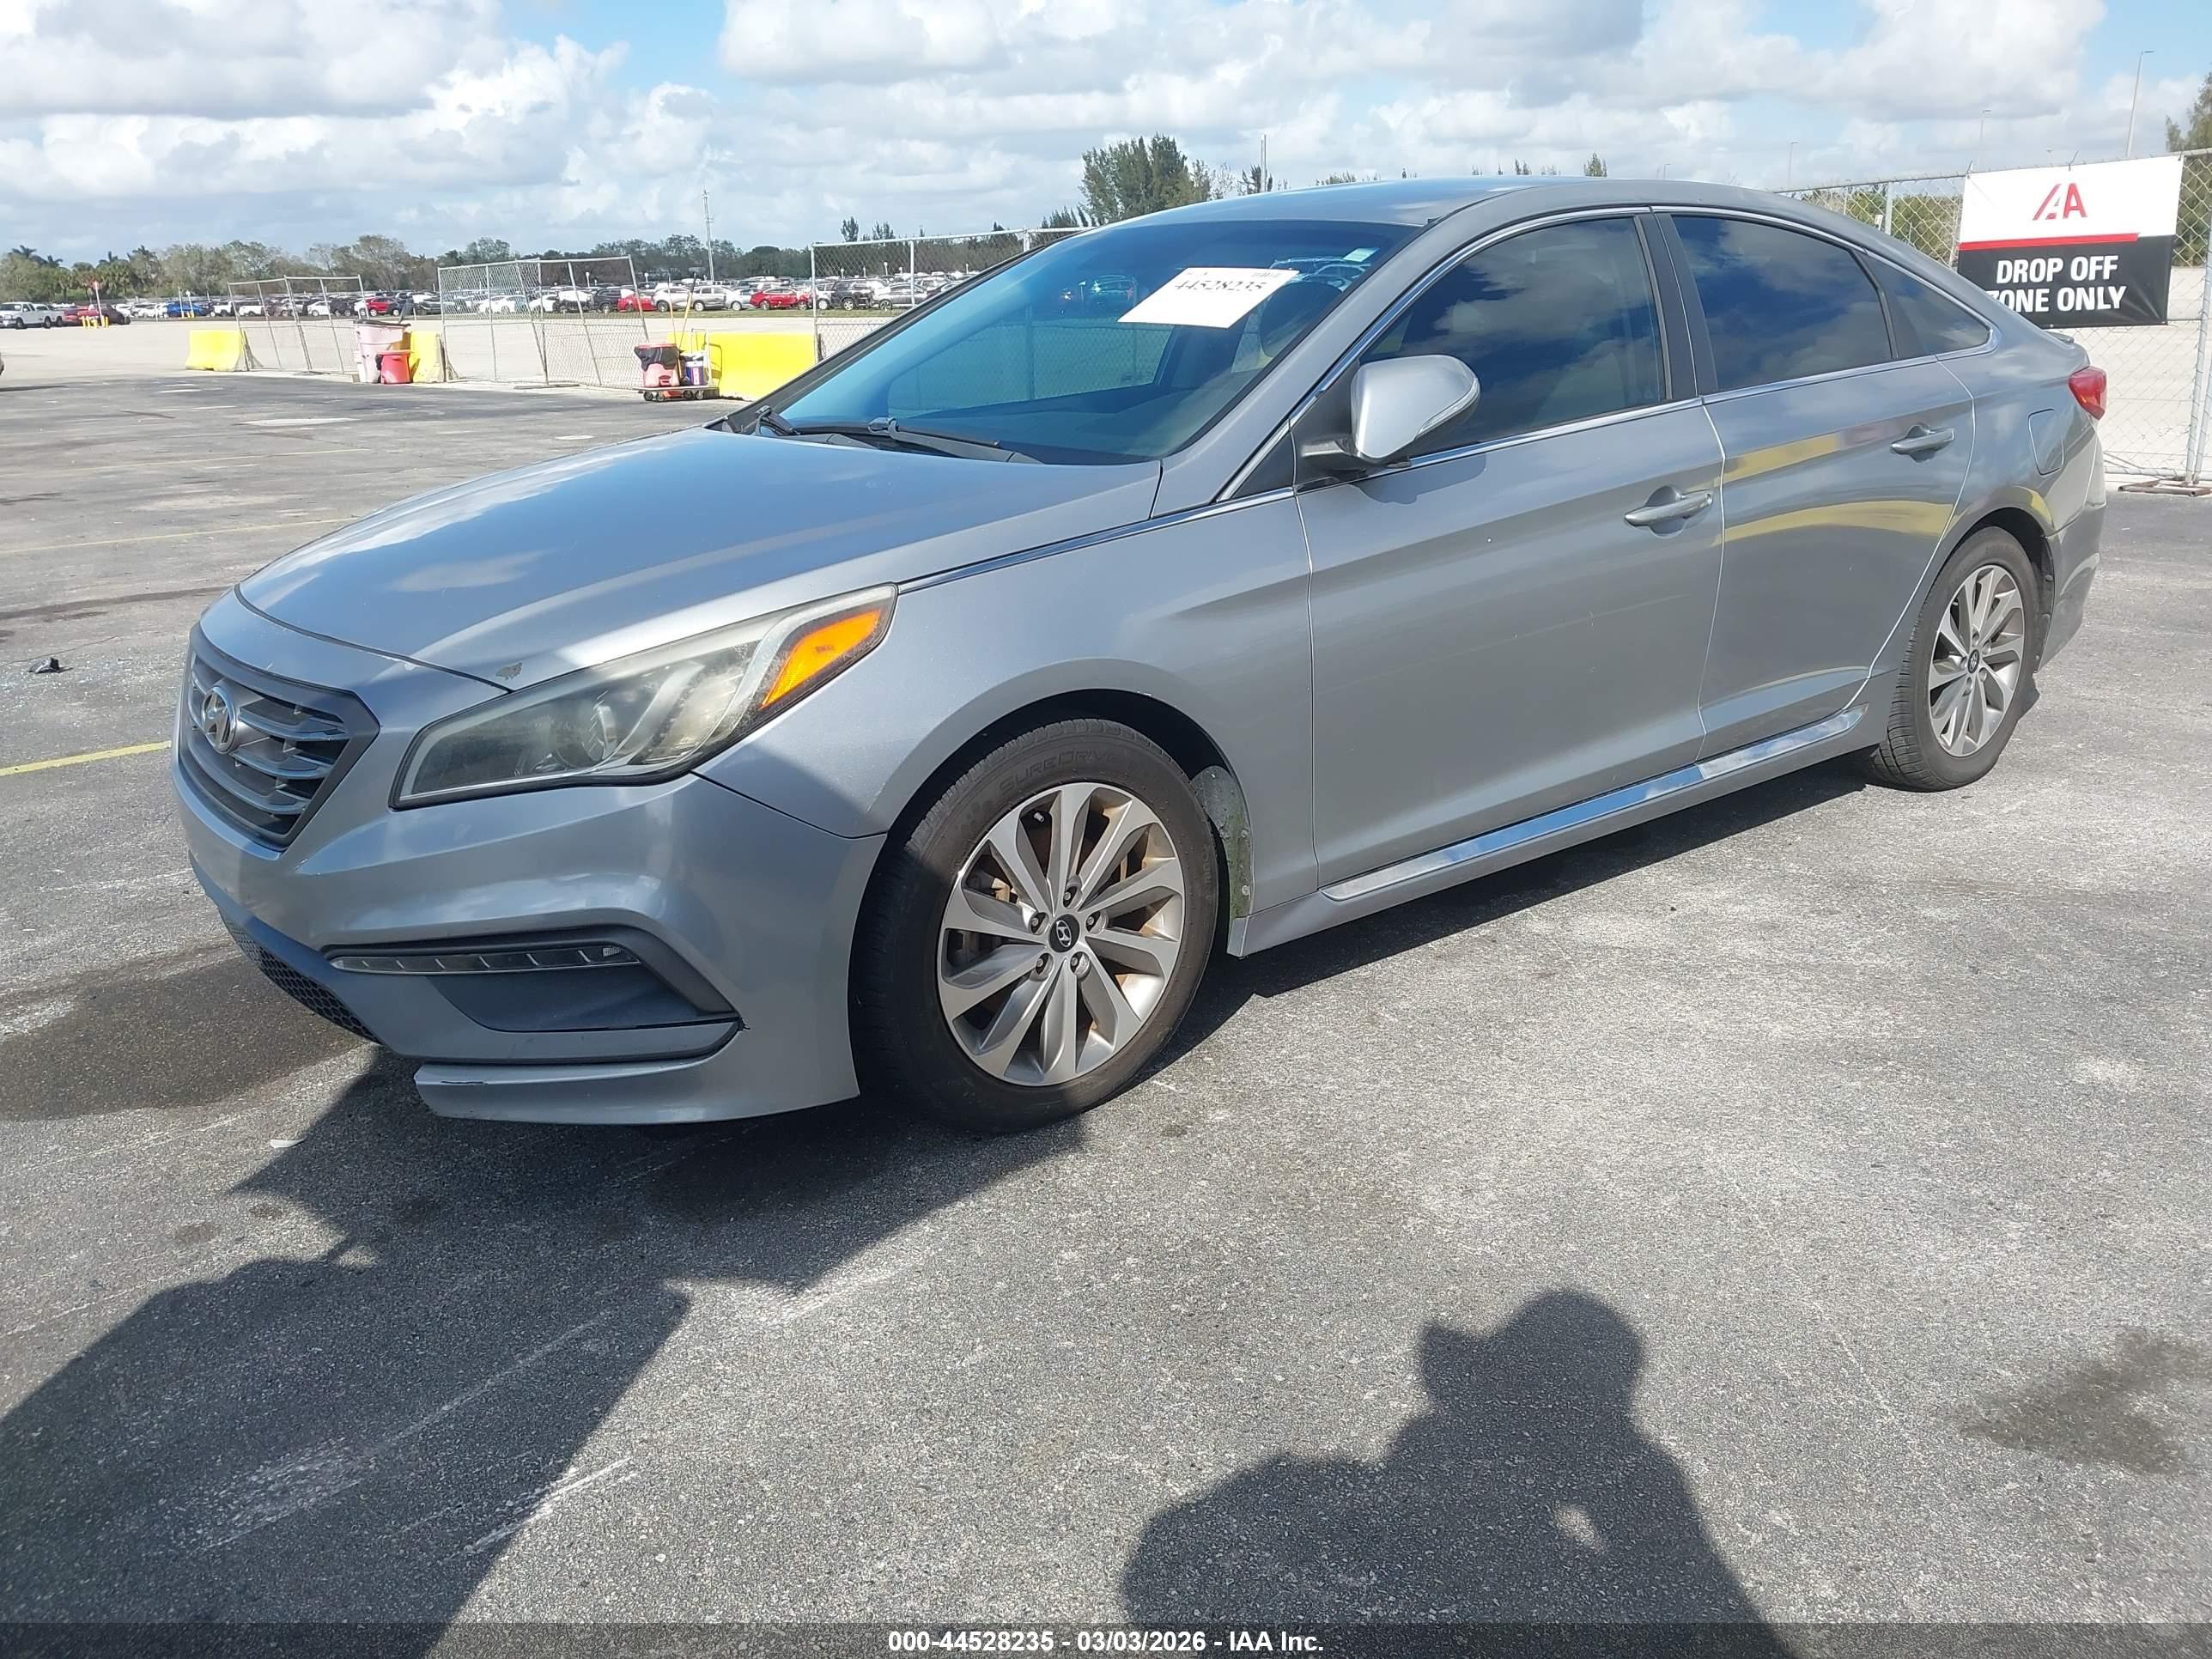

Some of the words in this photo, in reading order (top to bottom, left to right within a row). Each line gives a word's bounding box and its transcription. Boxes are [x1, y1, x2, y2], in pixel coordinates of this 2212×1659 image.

[1996, 258, 2063, 284] DROP
[2070, 255, 2119, 281] OFF
[2057, 286, 2127, 311] ONLY
